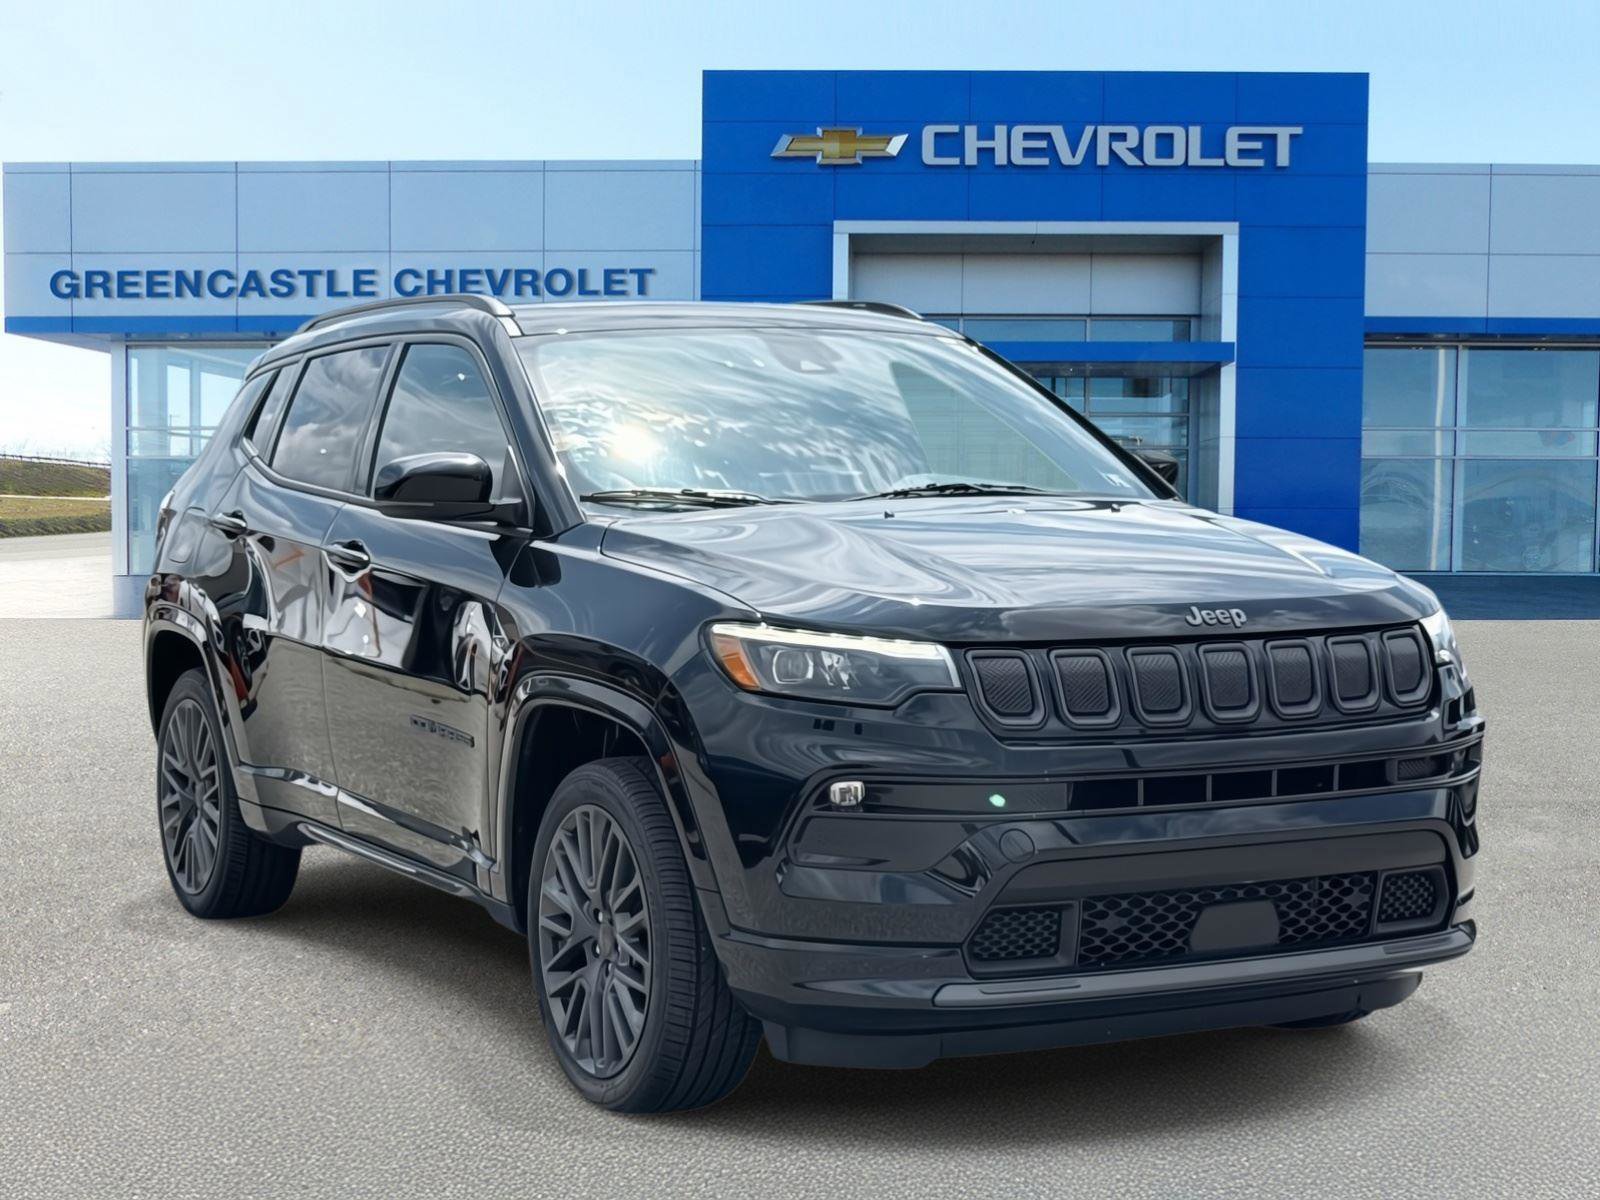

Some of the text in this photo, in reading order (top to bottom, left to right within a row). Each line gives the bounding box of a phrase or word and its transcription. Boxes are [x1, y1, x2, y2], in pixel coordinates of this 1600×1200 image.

[921, 124, 1304, 167] CHEVROLET
[50, 267, 655, 299] GREENCASTLE CHEVROLET
[1185, 605, 1247, 628] Jeep
